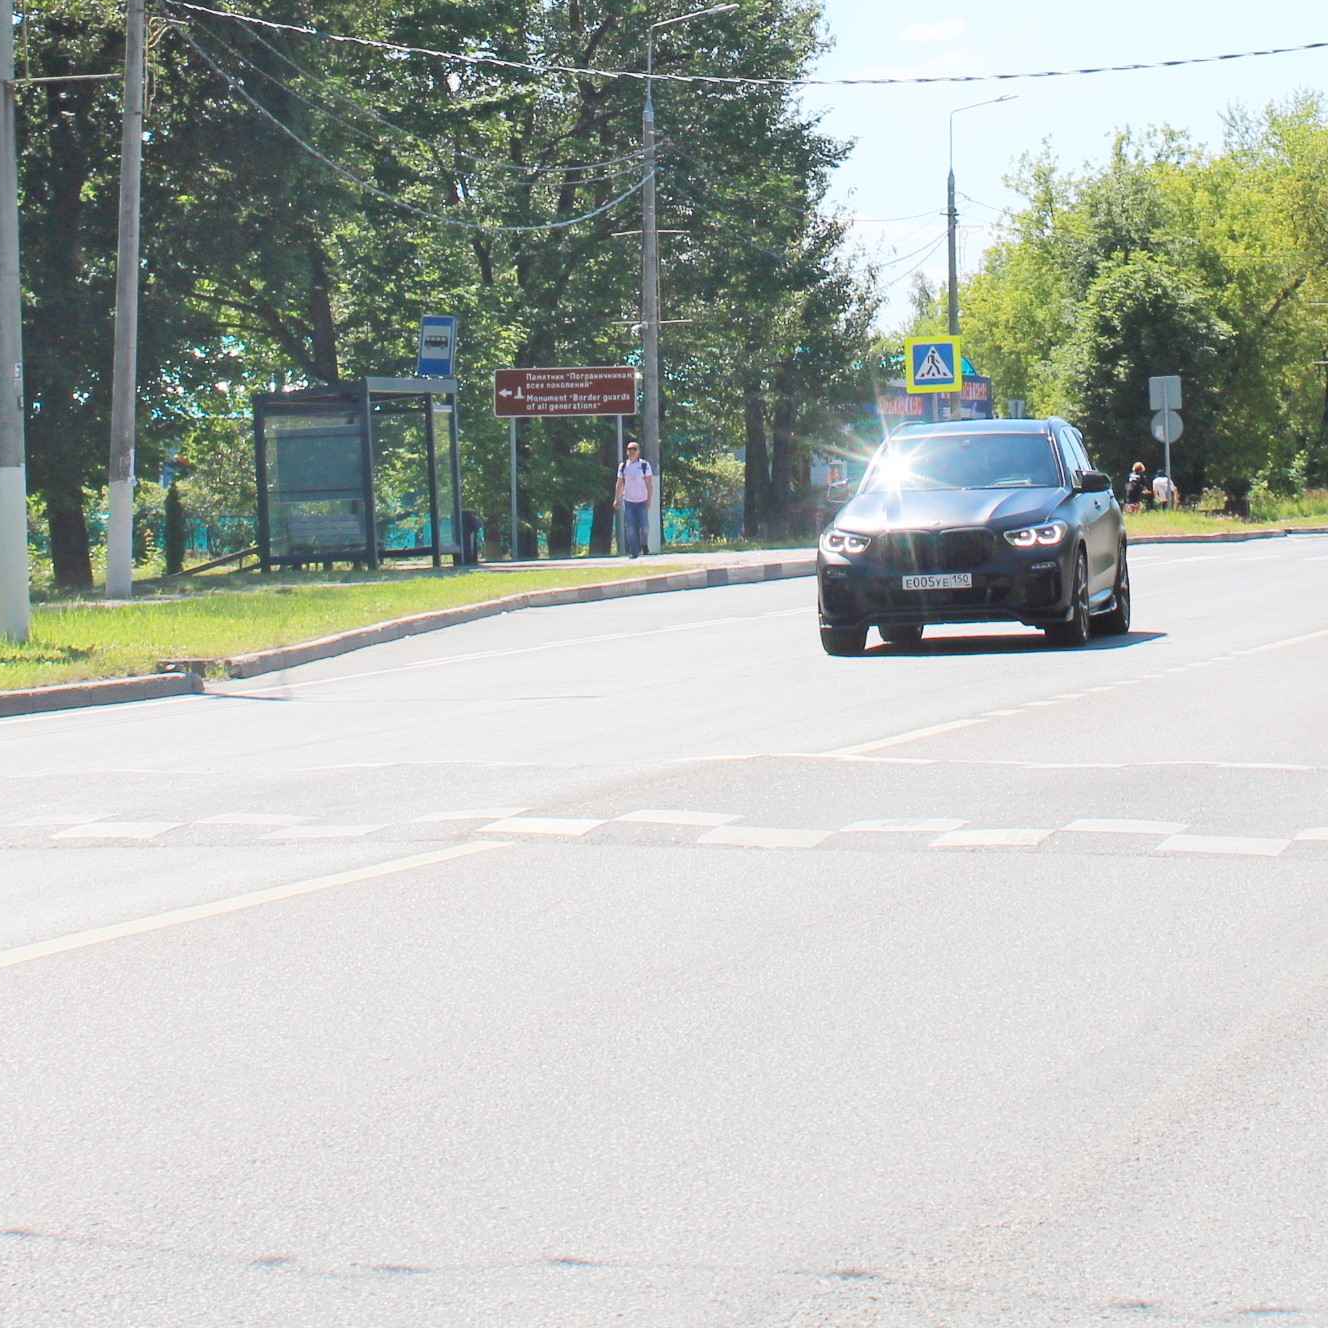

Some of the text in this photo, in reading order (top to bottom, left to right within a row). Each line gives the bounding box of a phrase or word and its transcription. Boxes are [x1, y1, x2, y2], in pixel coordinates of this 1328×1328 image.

[526, 373, 564, 381] Памятник
[526, 394, 567, 402] Monument
[603, 393, 630, 403] guards
